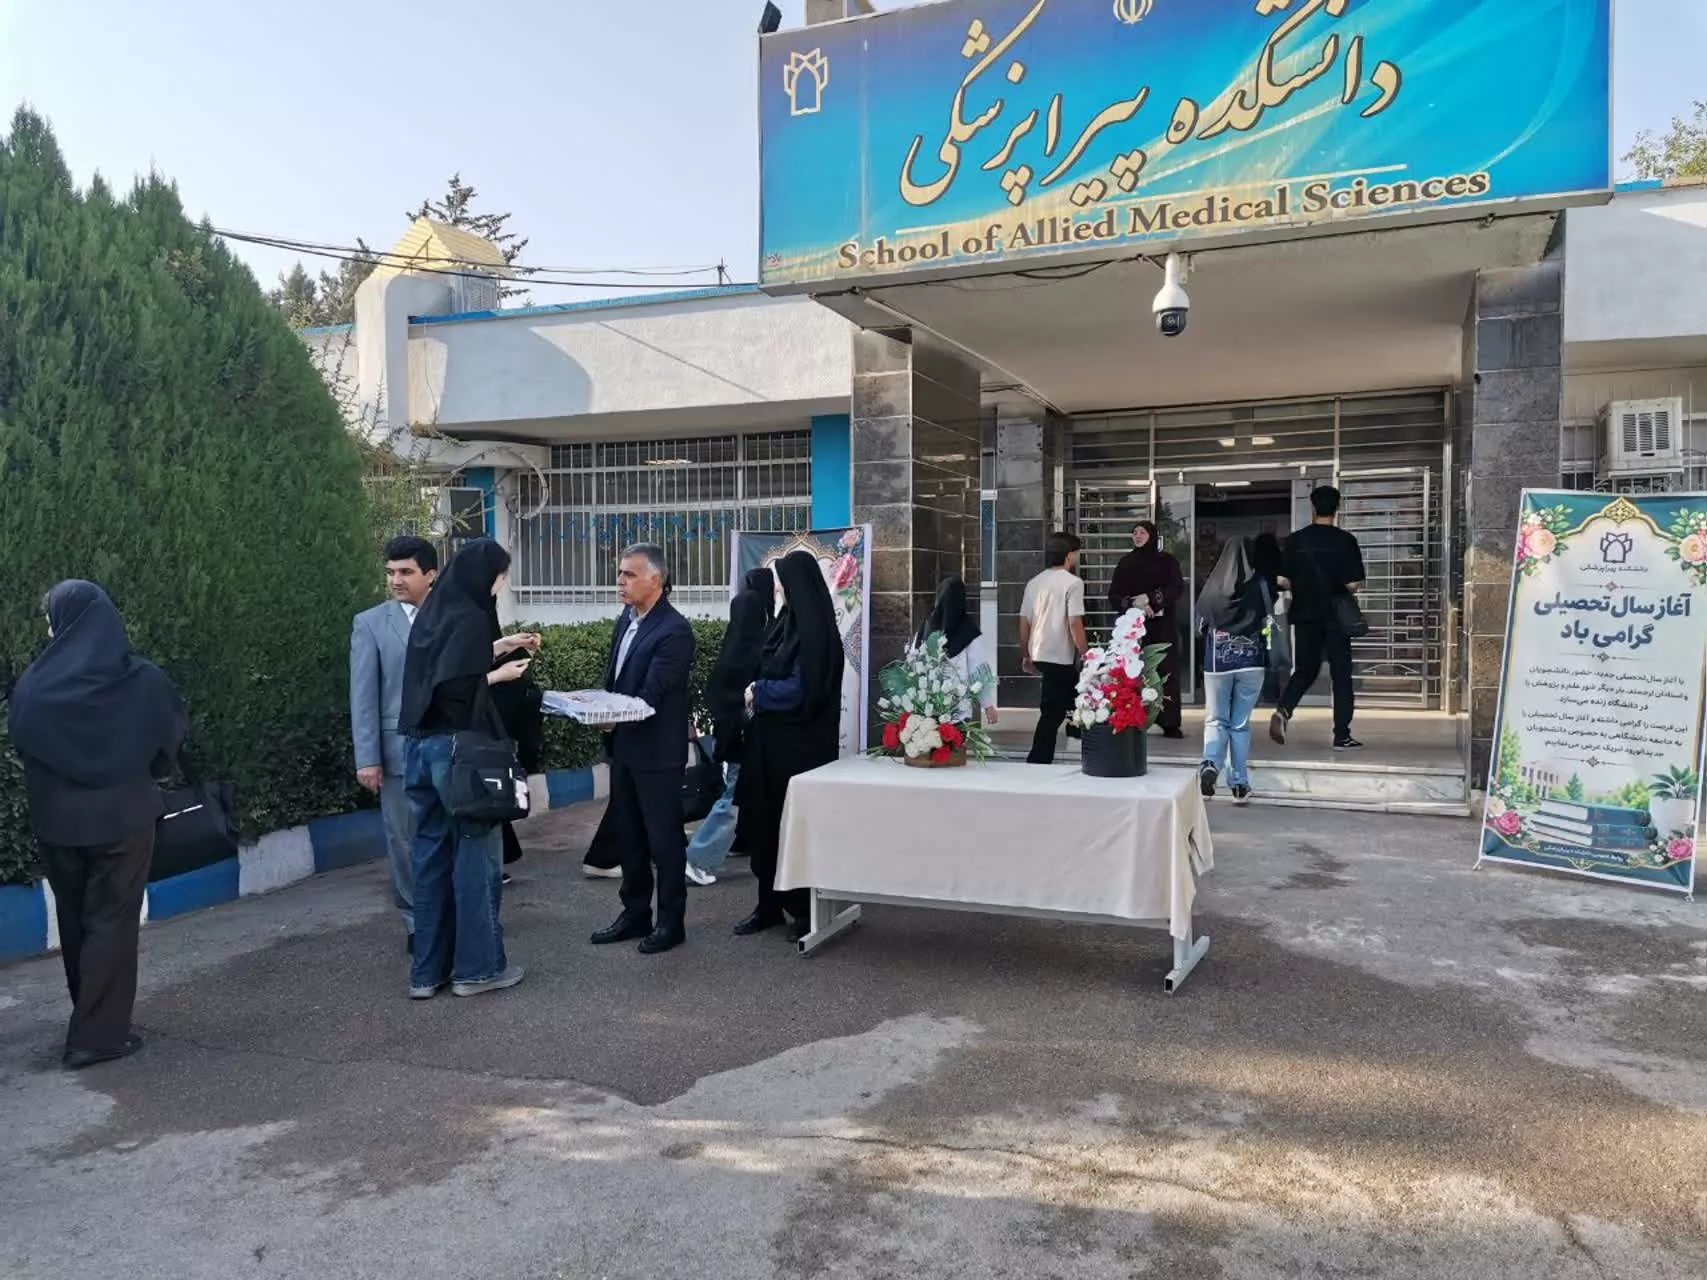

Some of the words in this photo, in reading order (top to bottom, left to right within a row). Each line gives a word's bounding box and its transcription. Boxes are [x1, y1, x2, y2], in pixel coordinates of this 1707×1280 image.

[899, 0, 1150, 207] پیراپزشکی
[837, 230, 950, 269] School
[963, 223, 1003, 254] of
[1008, 209, 1117, 249] Allied
[1129, 186, 1288, 234] Medical
[1302, 173, 1490, 214] Sciences
[1533, 591, 1612, 616] تحصیلی
[1610, 596, 1656, 618] سال
[1652, 592, 1692, 620] آغاز
[1560, 619, 1589, 645] باد
[1592, 622, 1655, 649] گرامی
